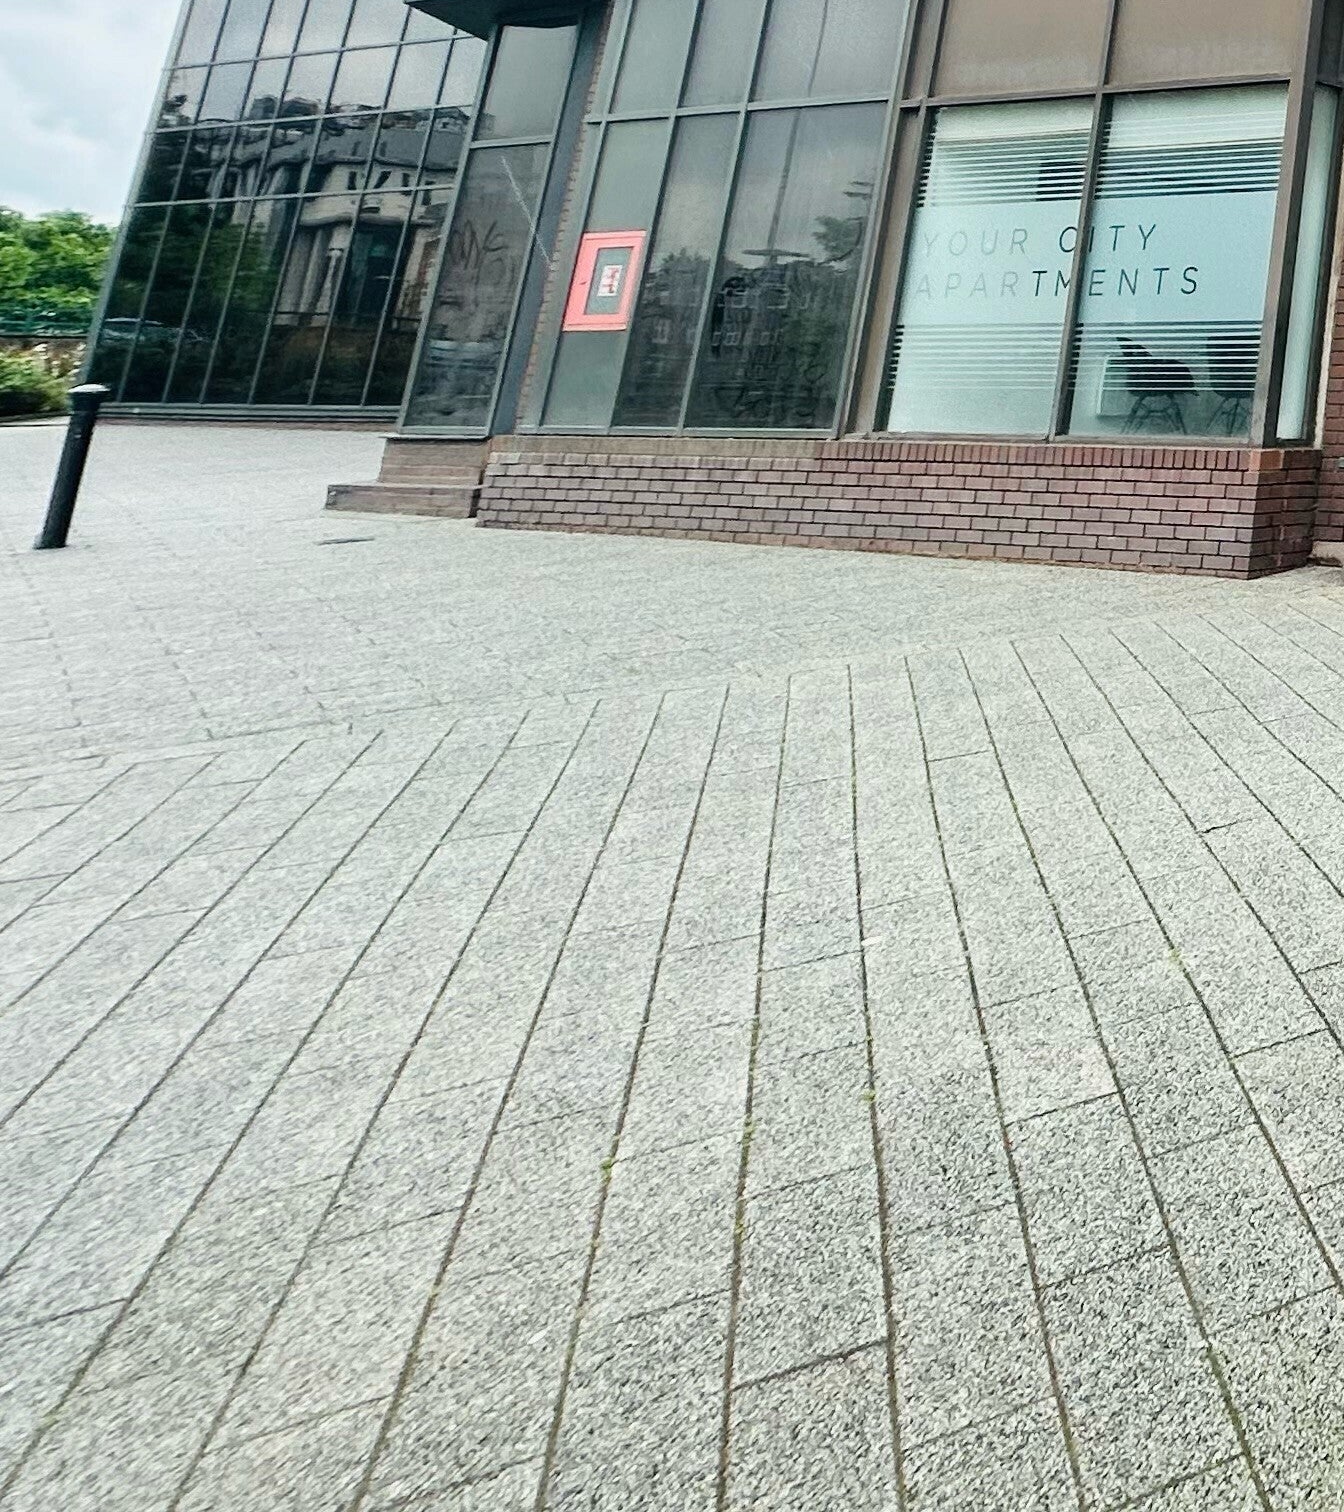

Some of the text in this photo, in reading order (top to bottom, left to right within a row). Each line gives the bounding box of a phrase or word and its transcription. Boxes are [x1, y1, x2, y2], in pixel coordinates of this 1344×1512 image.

[922, 223, 1158, 260] YOUR CITY
[915, 266, 1200, 301] APARTMENTS
